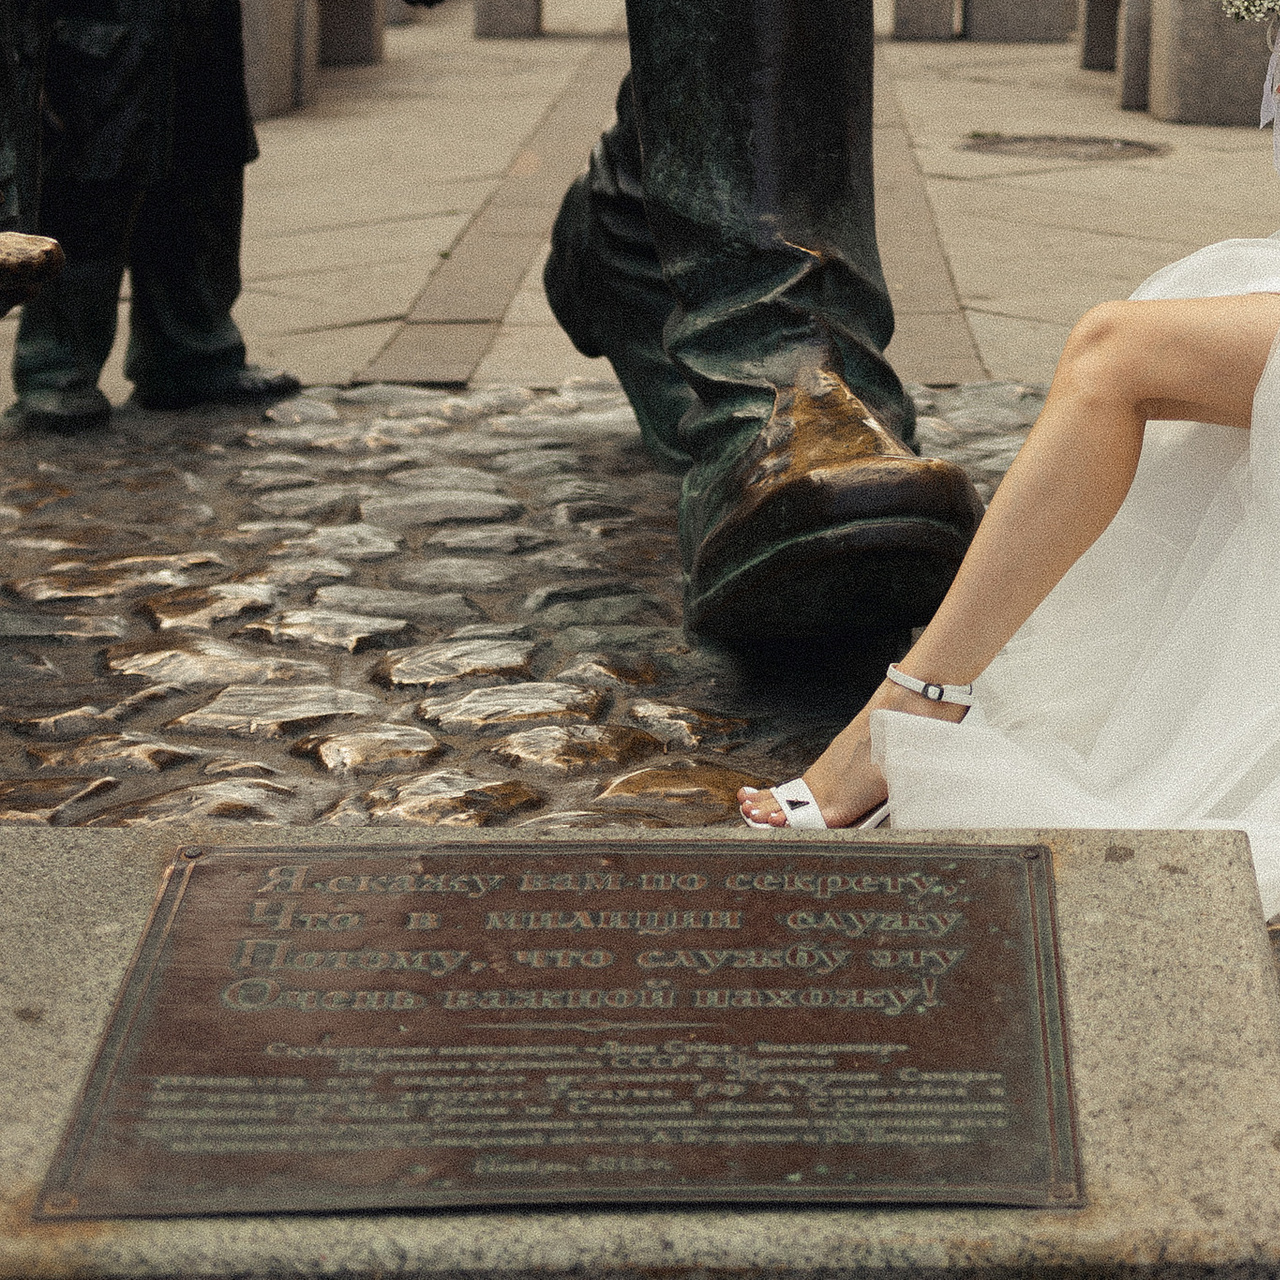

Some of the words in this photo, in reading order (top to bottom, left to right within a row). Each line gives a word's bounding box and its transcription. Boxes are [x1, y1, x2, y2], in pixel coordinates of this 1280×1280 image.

[257, 863, 311, 894] Я
[327, 871, 505, 900] скажу
[518, 870, 624, 893] вам
[639, 870, 708, 893] по
[250, 899, 363, 931] Что
[406, 910, 443, 931] в
[484, 909, 743, 936] милиции
[785, 909, 963, 938] служу
[514, 948, 615, 969] что
[635, 945, 853, 976] службу
[869, 948, 965, 976] эту
[221, 977, 428, 1012] Очень
[442, 979, 676, 1012] важной
[694, 977, 945, 1017] нахожу!
